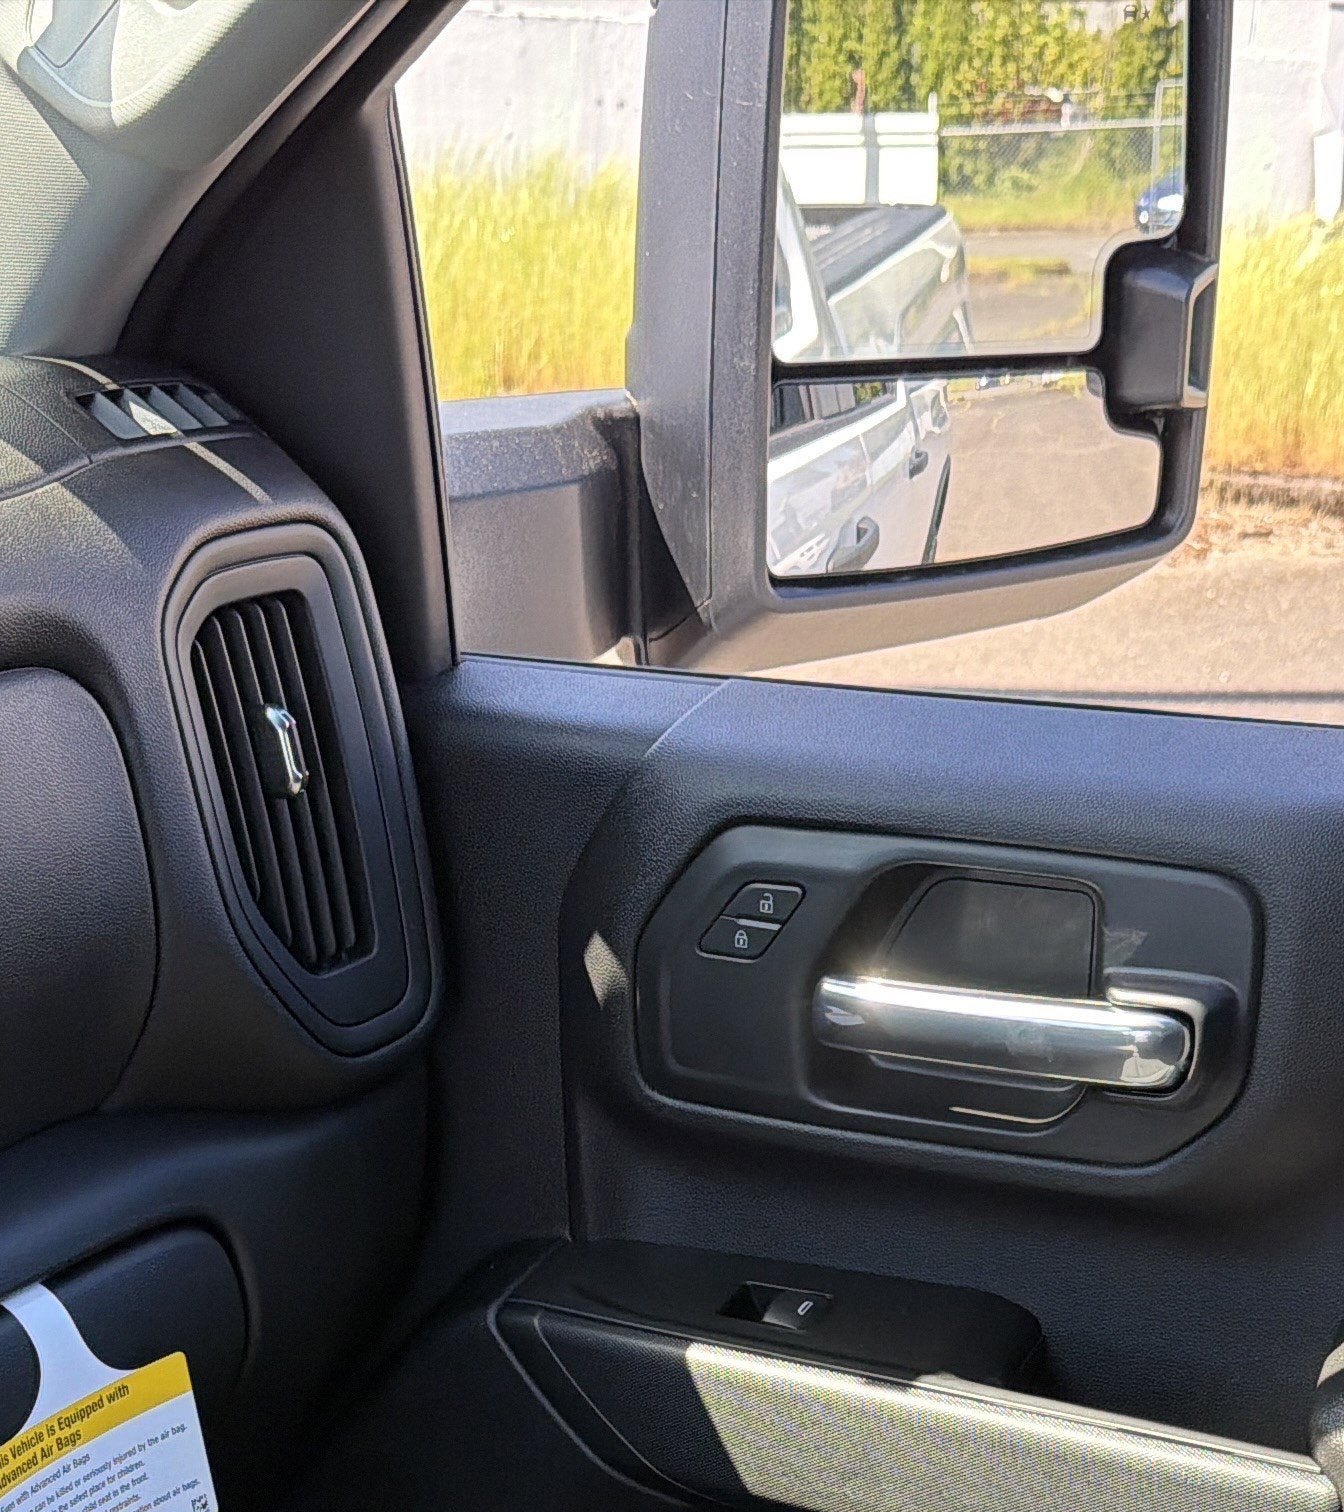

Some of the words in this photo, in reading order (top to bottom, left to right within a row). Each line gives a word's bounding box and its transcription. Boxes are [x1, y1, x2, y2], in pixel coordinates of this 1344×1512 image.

[9, 1431, 45, 1460] Vehicle
[56, 1394, 105, 1432] Equipped
[105, 1383, 130, 1405] with
[40, 1444, 54, 1462] Air
[55, 1429, 82, 1452] Bags
[15, 1490, 30, 1506] with
[30, 1468, 62, 1497] Advanced
[62, 1463, 72, 1476] Air
[72, 1453, 91, 1469] Bags
[34, 1500, 46, 1512] can
[46, 1495, 55, 1506] be
[55, 1481, 74, 1500] killed
[82, 1460, 112, 1483] seriously
[112, 1446, 137, 1465] injured
[137, 1442, 146, 1453] by
[147, 1436, 159, 1447] the
[160, 1430, 170, 1441] air
[171, 1423, 188, 1435] bag.
[69, 1489, 89, 1508] safest
[88, 1480, 106, 1497] place
[106, 1474, 116, 1485] for
[97, 1491, 112, 1507] seat
[119, 1482, 131, 1494] the
[153, 1491, 172, 1507] about
[172, 1486, 181, 1497] air
